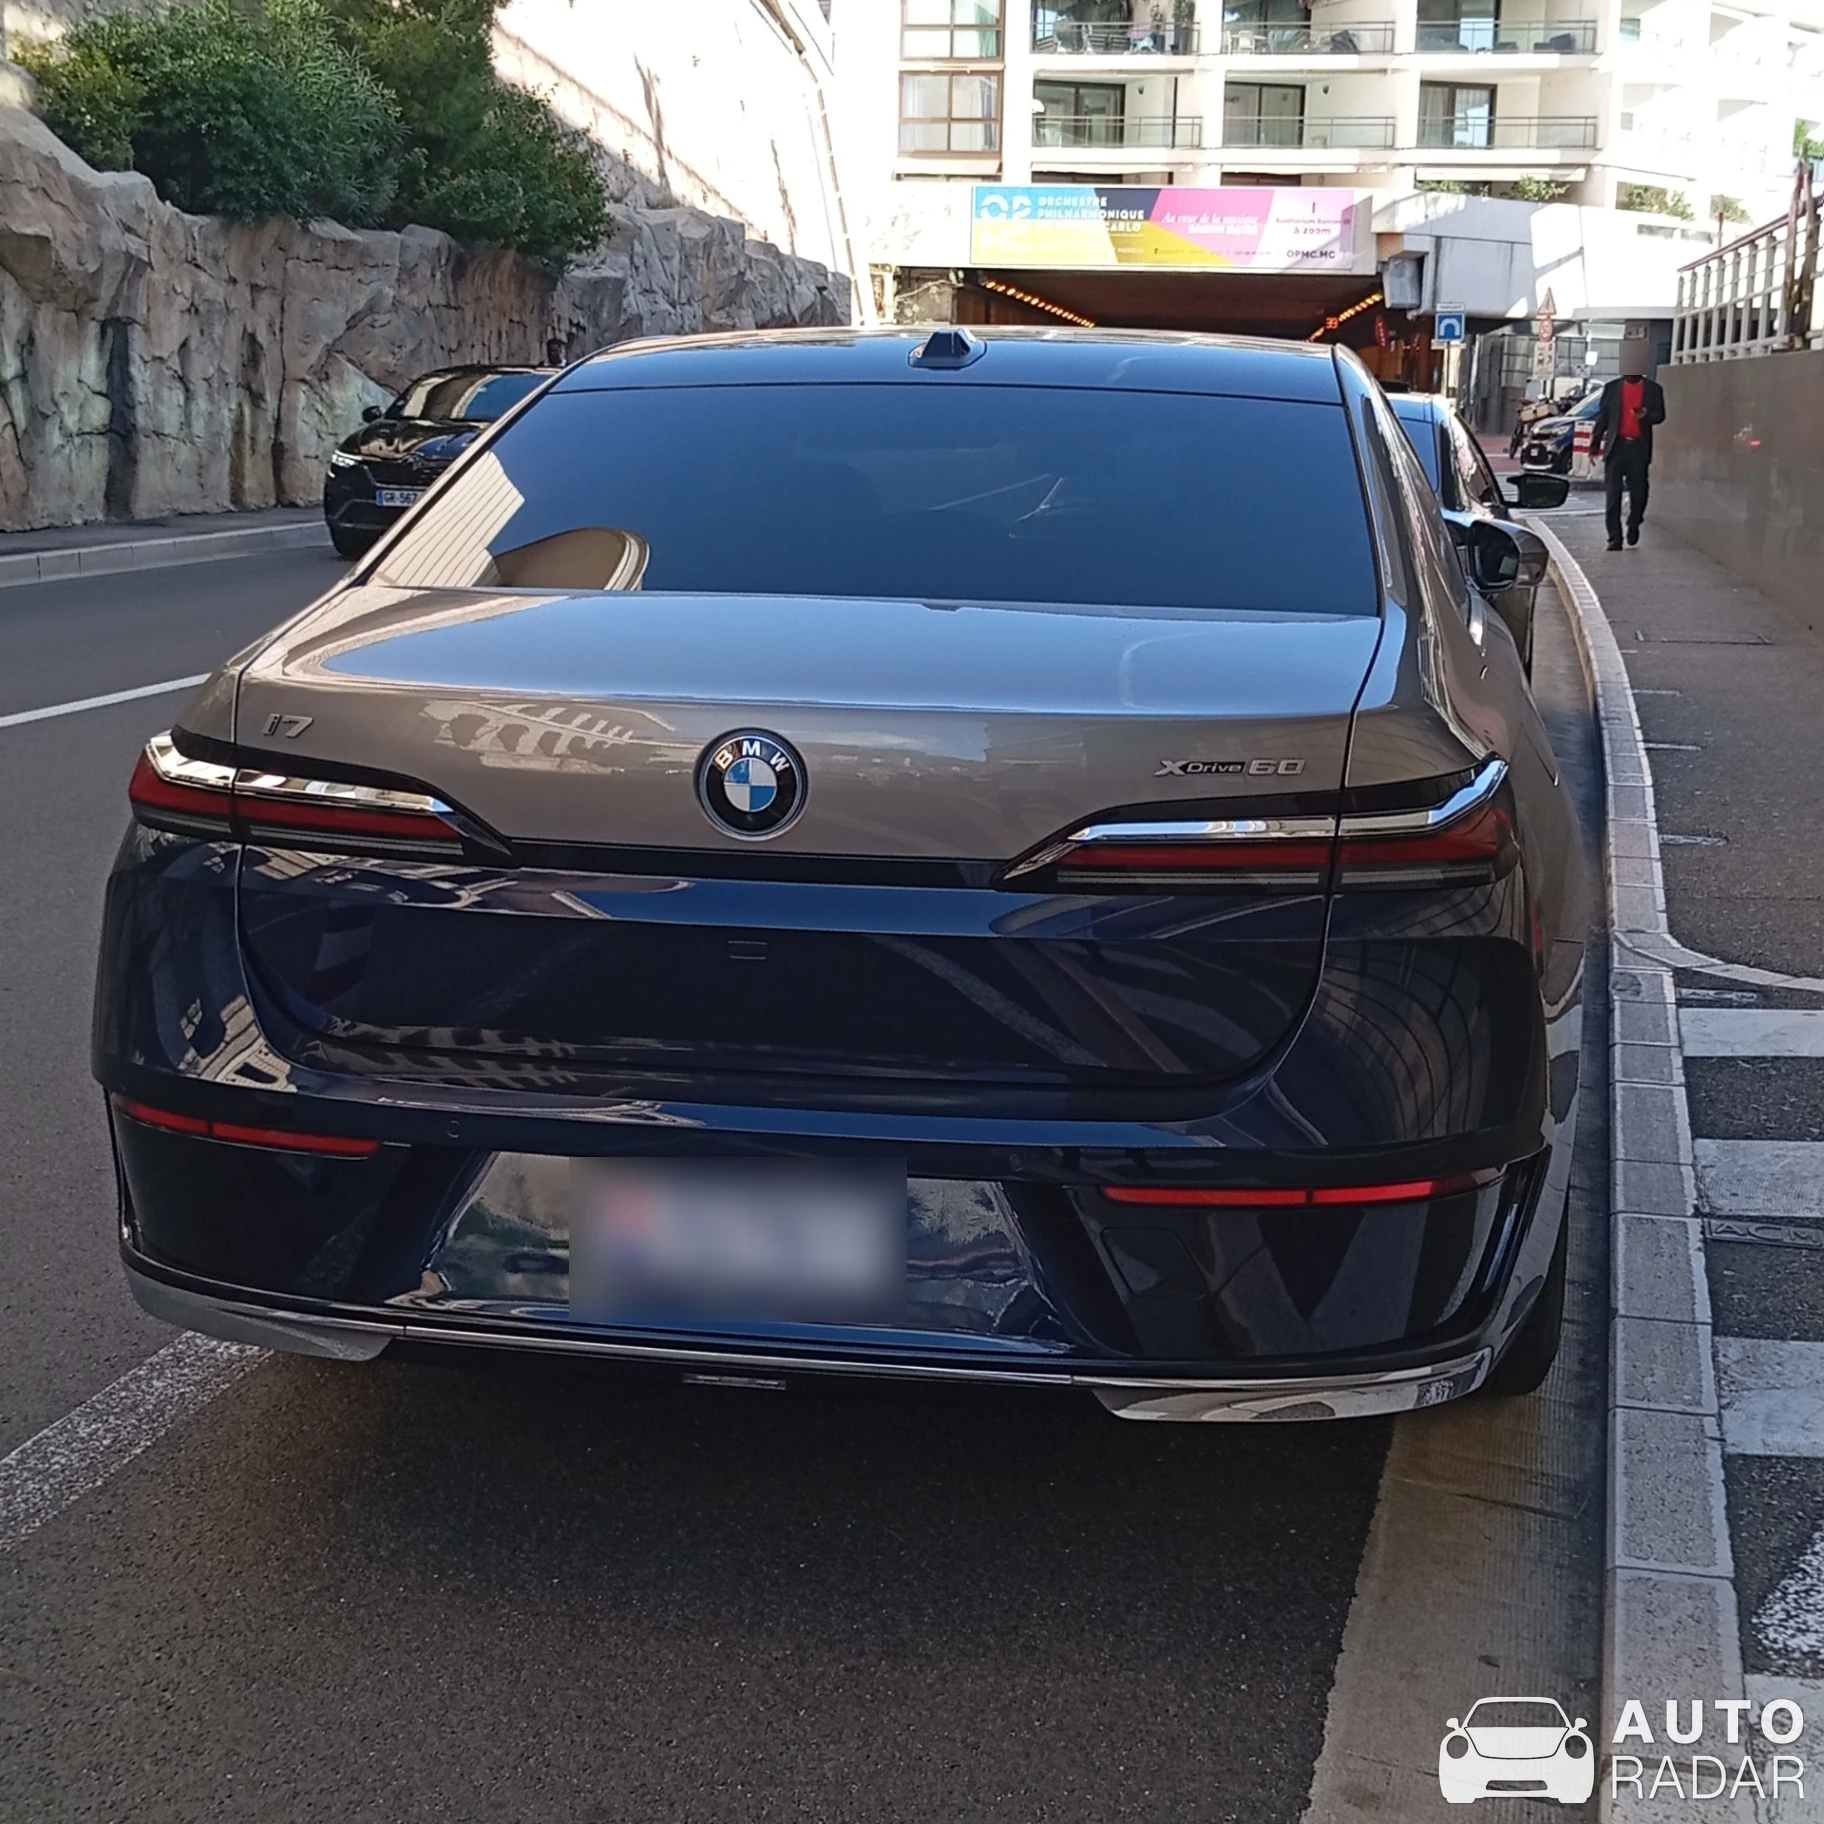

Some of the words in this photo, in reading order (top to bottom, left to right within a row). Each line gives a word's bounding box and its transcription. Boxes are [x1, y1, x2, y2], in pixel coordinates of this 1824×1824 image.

[1037, 195, 1108, 207] ORCHESTRE
[1037, 208, 1145, 220] PHILHARMONIQUE
[1286, 249, 1336, 260] OPMC.MC
[261, 712, 315, 738] i7
[714, 740, 790, 773] BMW
[1249, 758, 1305, 775] 60
